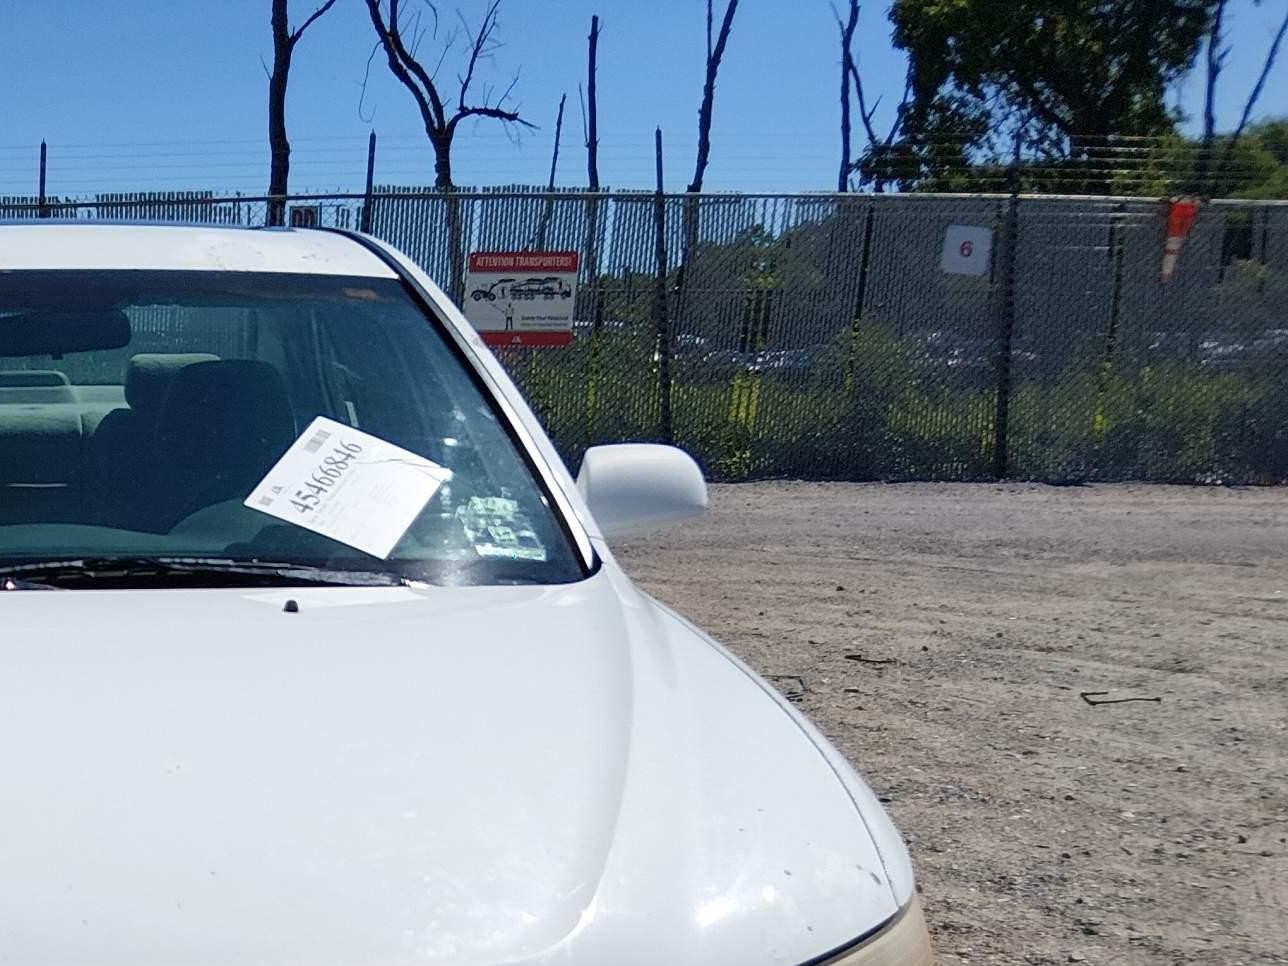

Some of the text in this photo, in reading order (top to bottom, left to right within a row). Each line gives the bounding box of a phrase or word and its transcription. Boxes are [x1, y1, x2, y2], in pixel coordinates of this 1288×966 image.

[959, 240, 974, 257] 6
[475, 256, 514, 267] ATTENTION
[289, 440, 363, 513] 45466846
